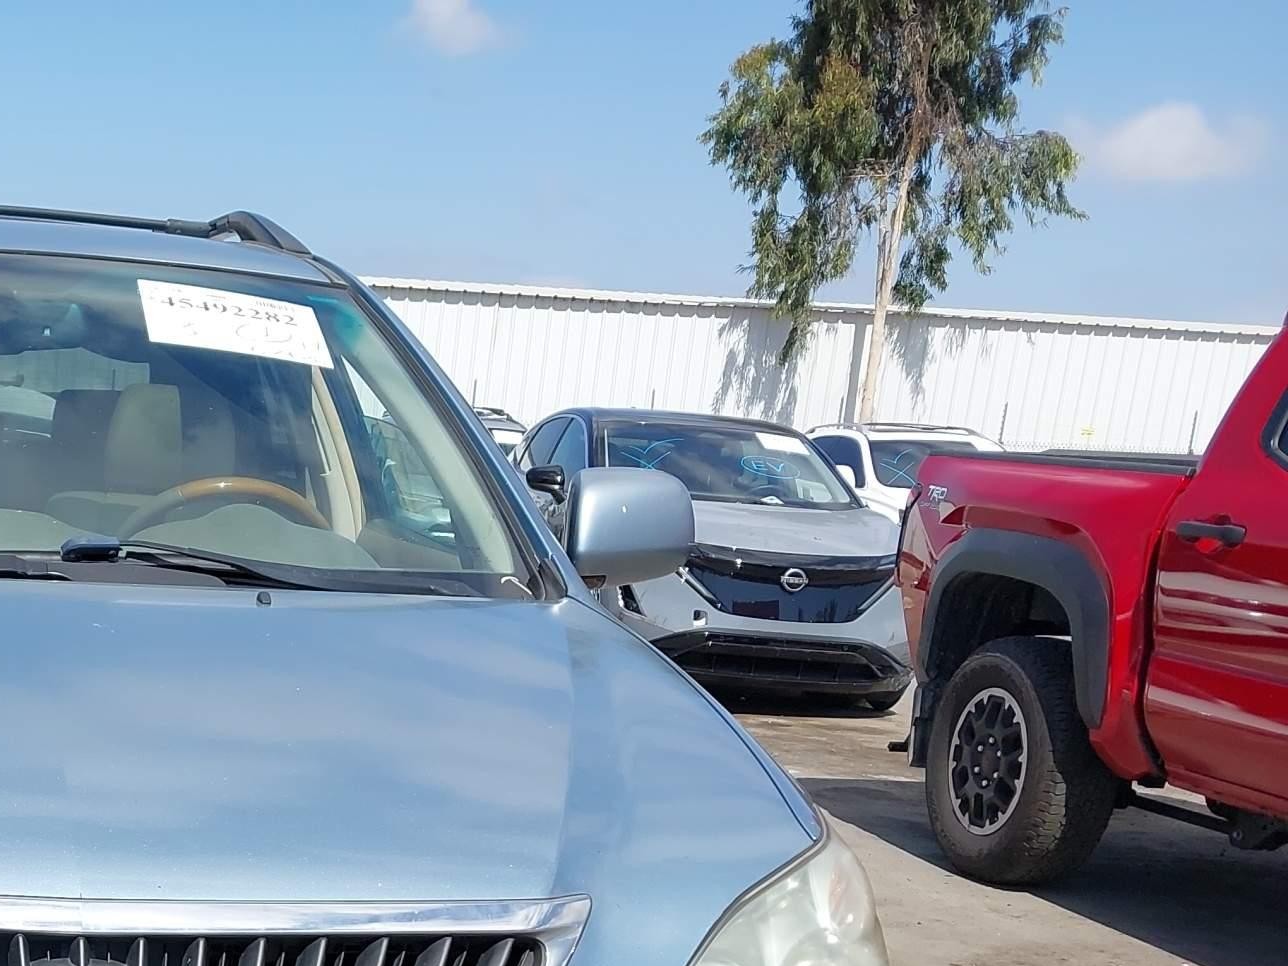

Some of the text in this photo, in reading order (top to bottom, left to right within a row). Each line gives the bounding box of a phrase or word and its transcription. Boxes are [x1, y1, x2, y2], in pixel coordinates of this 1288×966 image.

[160, 295, 298, 327] 45492282
[751, 460, 785, 473] EV
[927, 485, 948, 502] TRD
